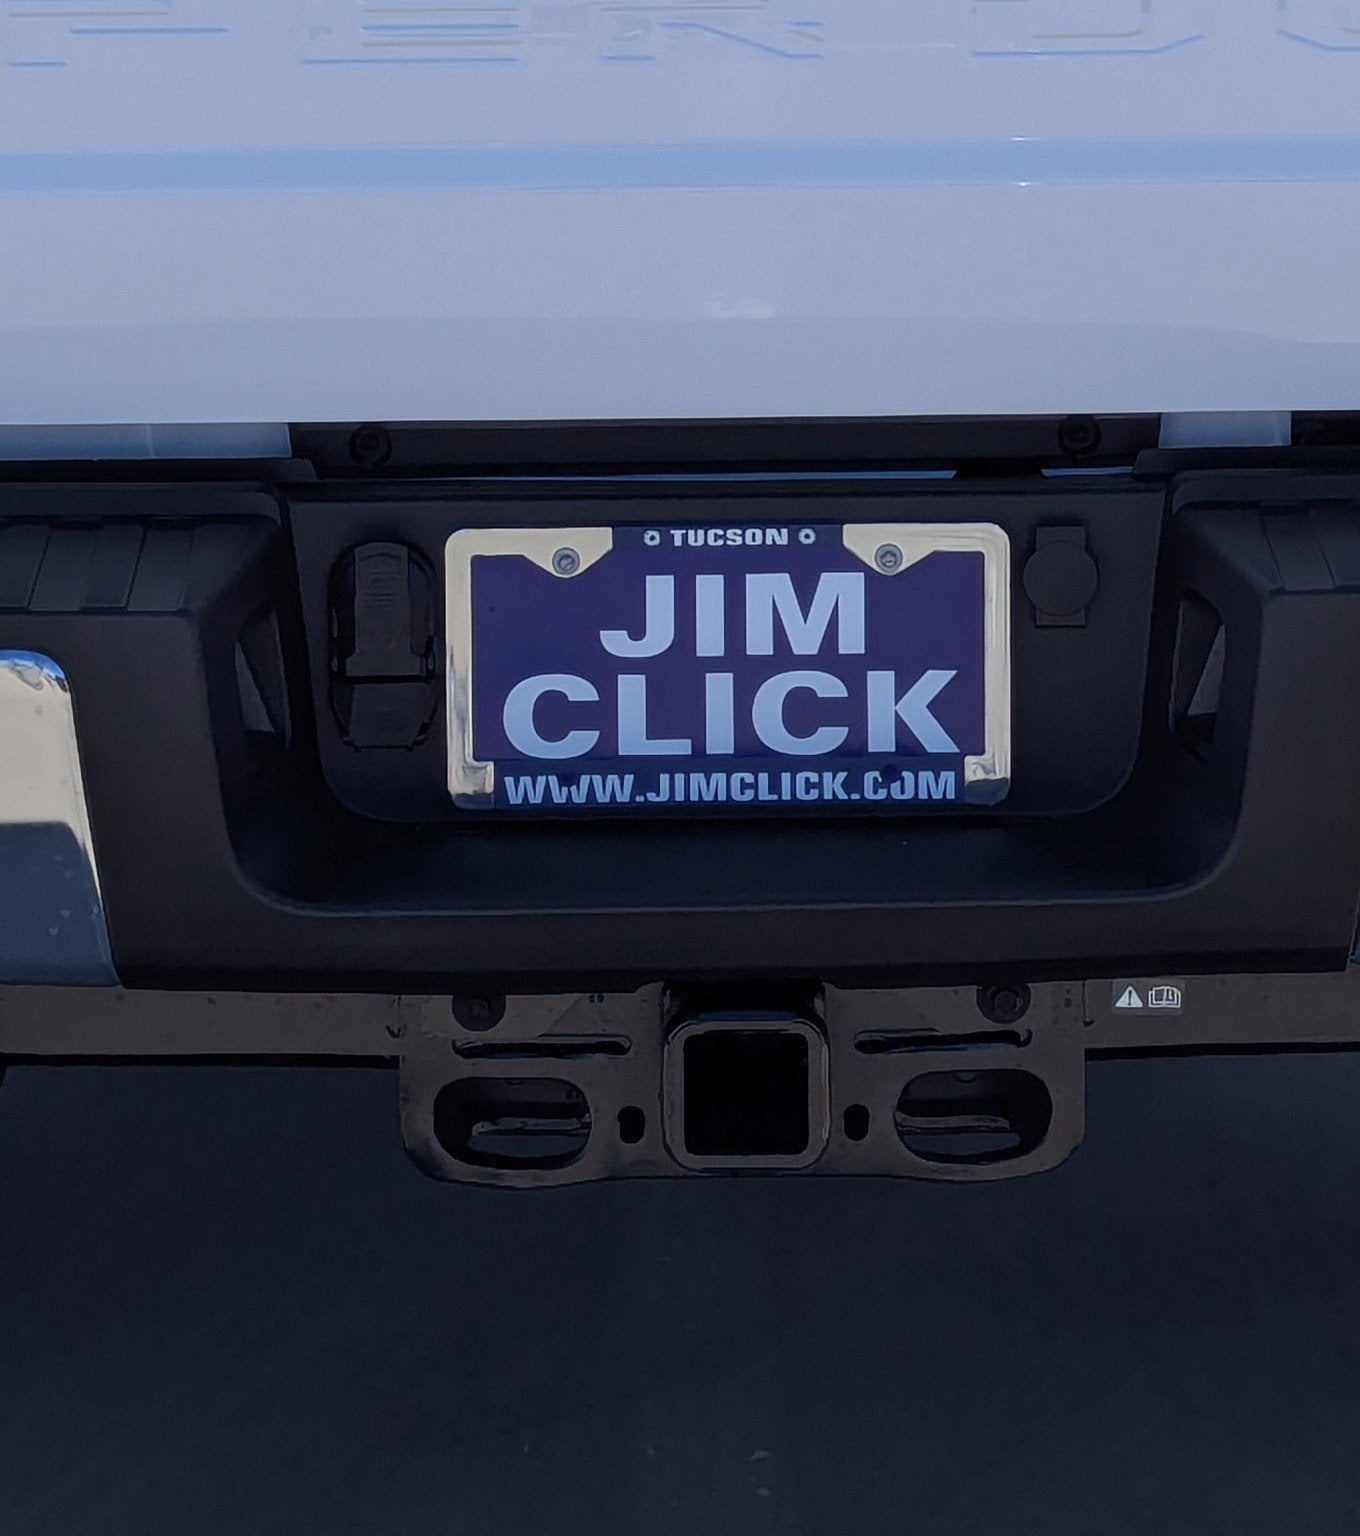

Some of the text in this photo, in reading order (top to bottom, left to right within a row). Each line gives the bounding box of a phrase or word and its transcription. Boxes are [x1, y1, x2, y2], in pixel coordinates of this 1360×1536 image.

[670, 527, 789, 547] TUCSON
[599, 571, 866, 659] JIM
[502, 669, 961, 760] CLICK
[504, 770, 957, 805] WWW.JIMCLICK.COM
